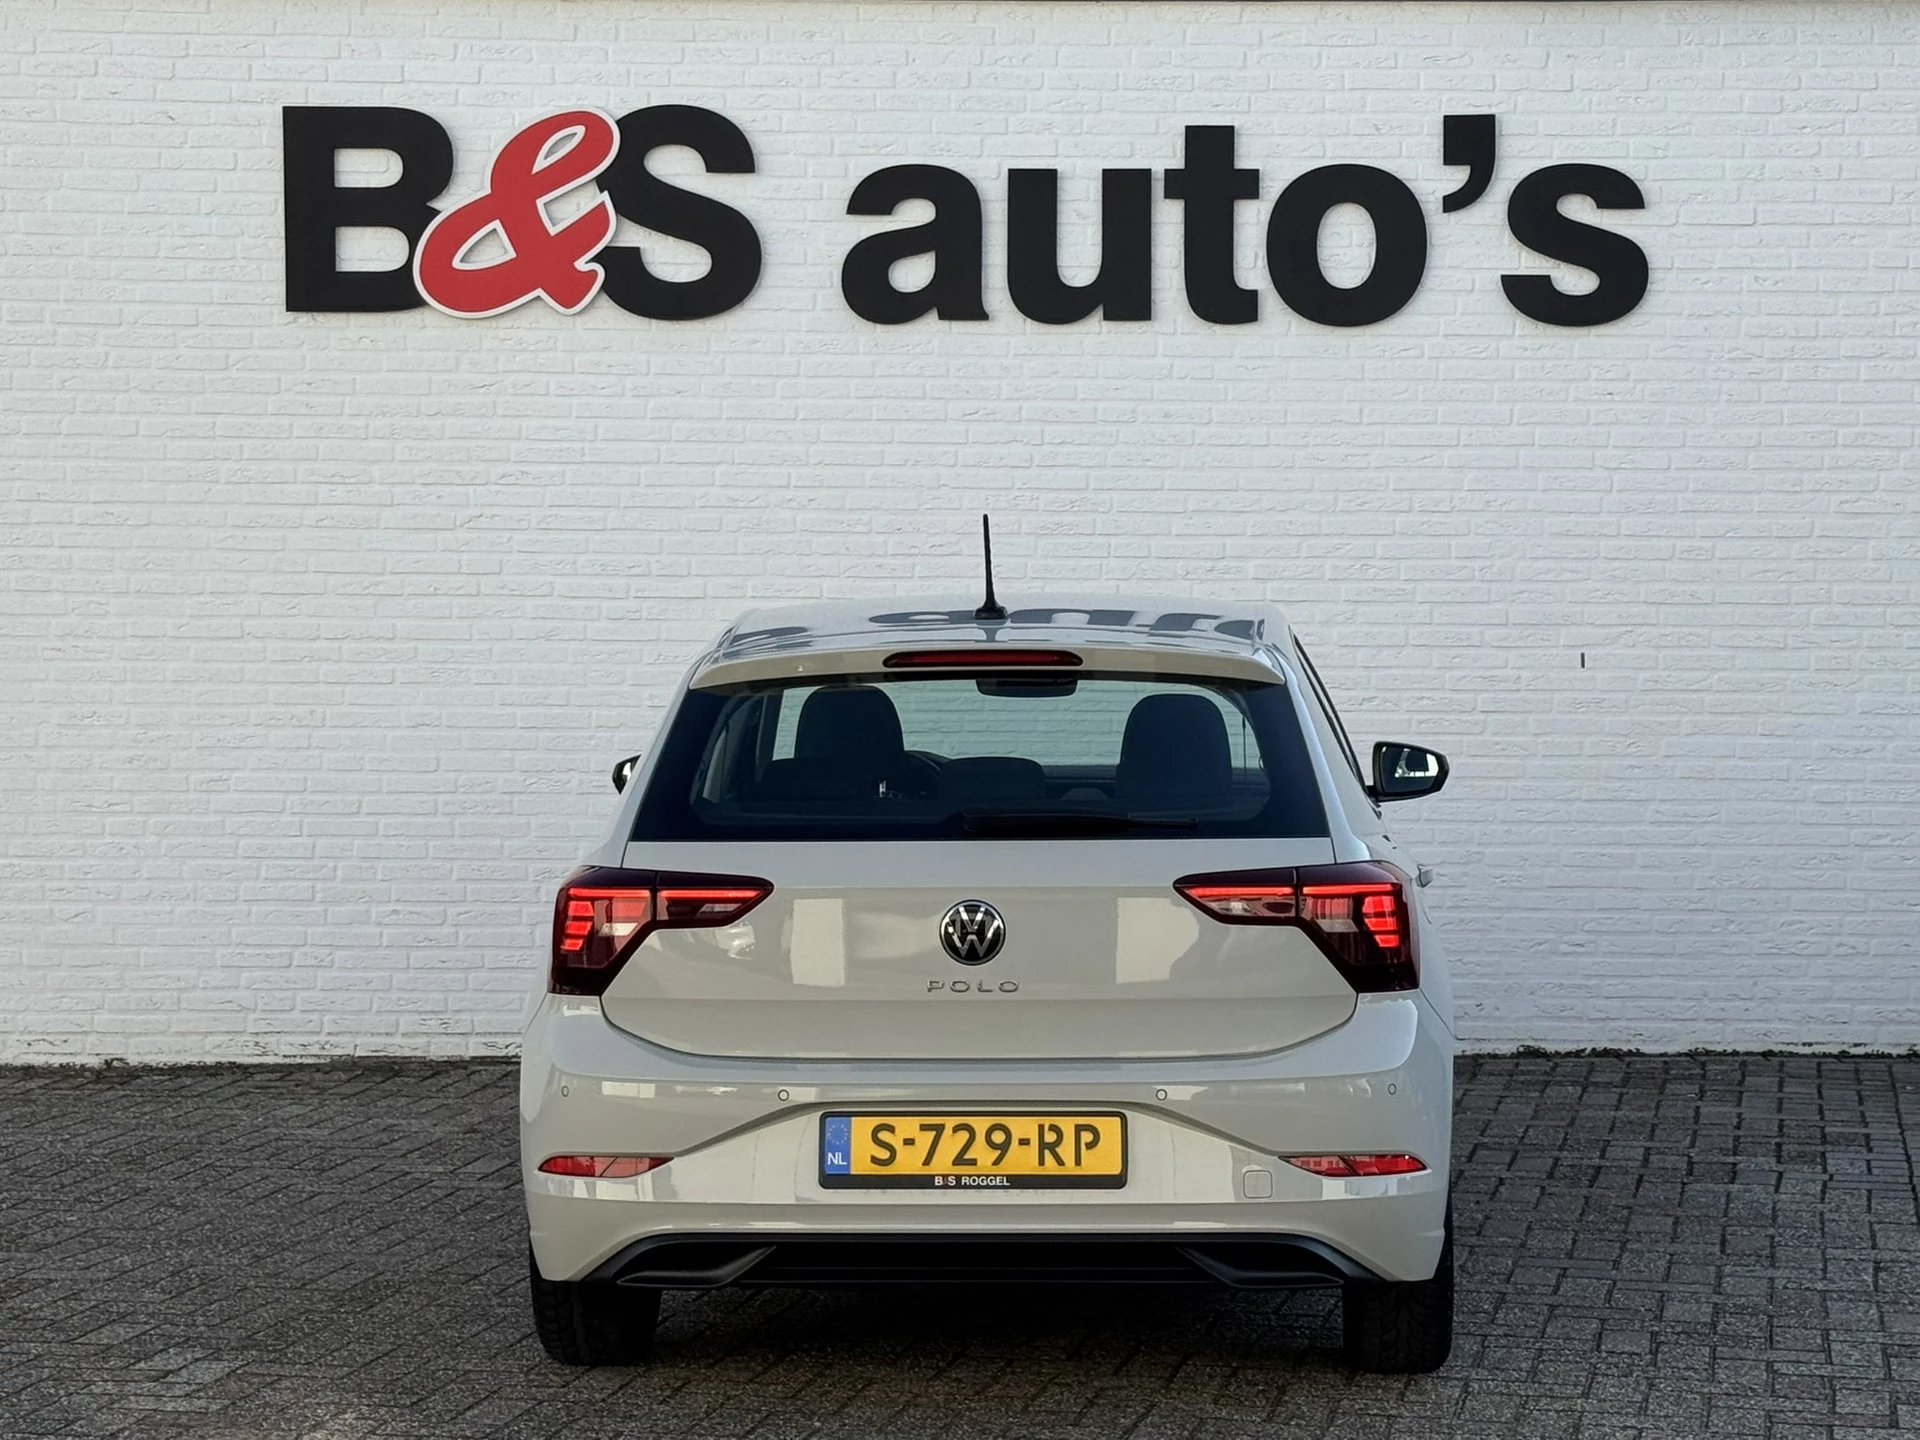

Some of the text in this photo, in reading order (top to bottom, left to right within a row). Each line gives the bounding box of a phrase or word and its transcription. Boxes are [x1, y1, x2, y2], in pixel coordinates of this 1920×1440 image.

[283, 104, 1651, 327] B&S auto's
[926, 980, 1019, 993] POLO
[870, 1122, 1101, 1167] S-729-RP
[827, 1152, 847, 1165] NL
[961, 1175, 1012, 1187] ROGGEL
